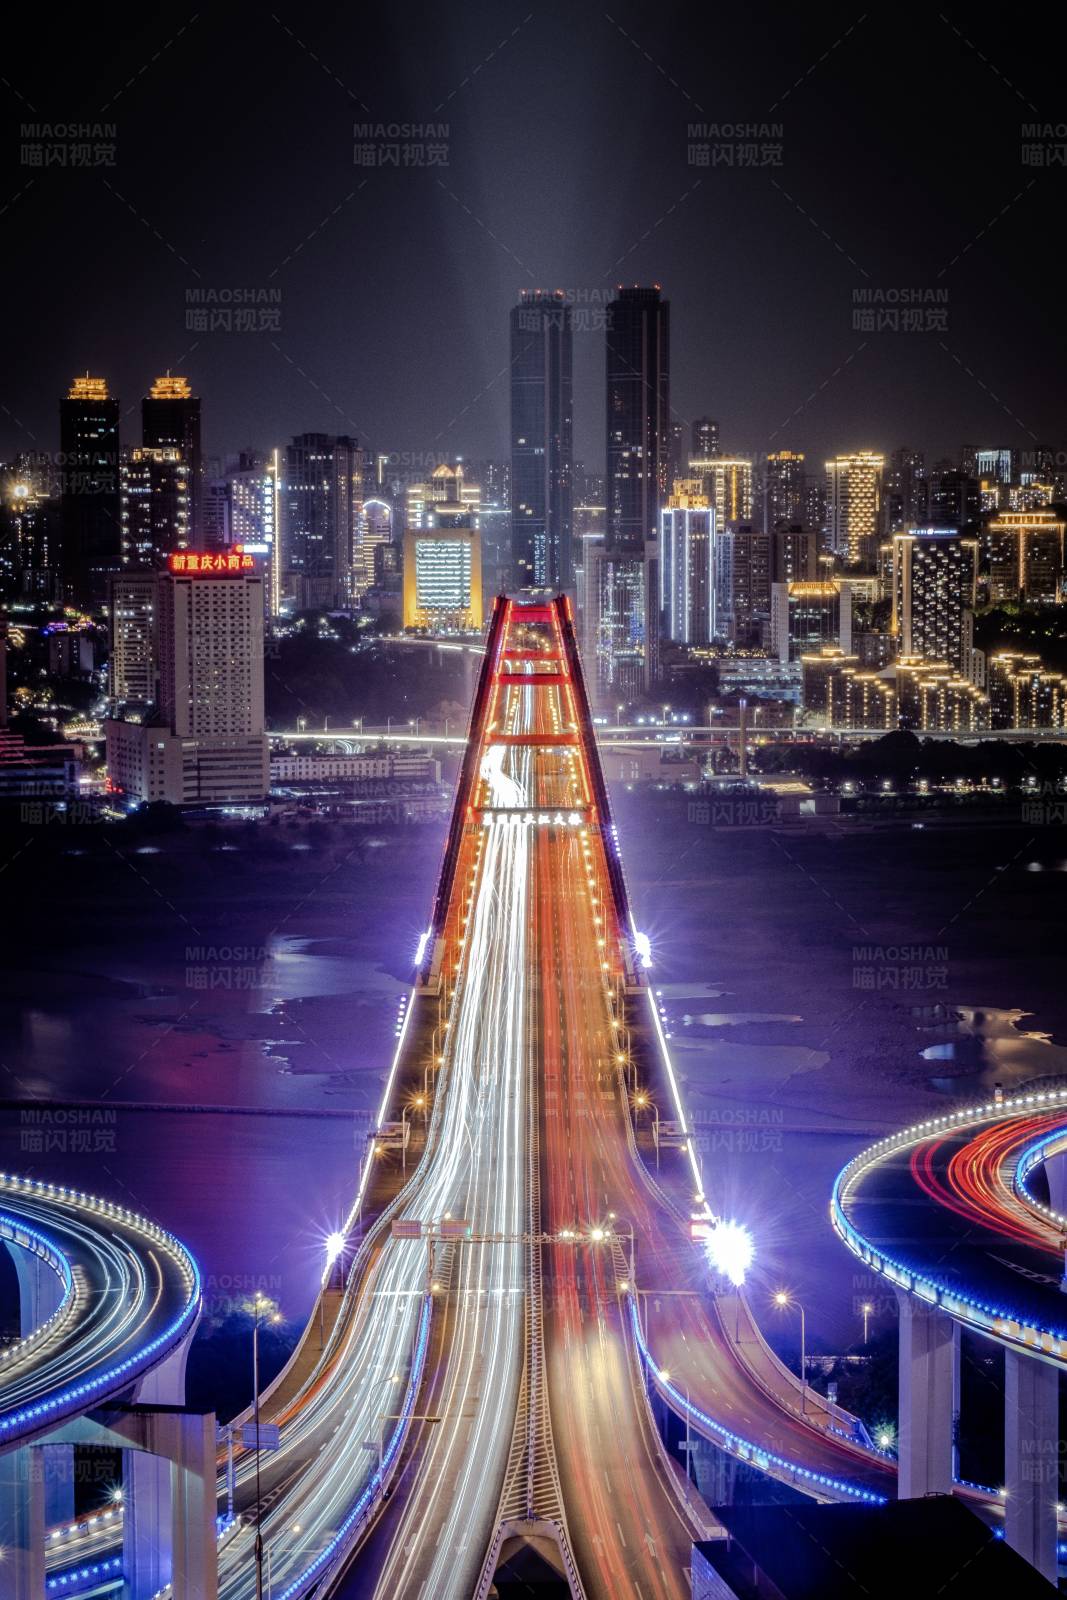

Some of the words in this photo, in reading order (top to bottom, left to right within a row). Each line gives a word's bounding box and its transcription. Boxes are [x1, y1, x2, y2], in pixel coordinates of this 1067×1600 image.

[173, 555, 253, 569] 新重庆小商品
